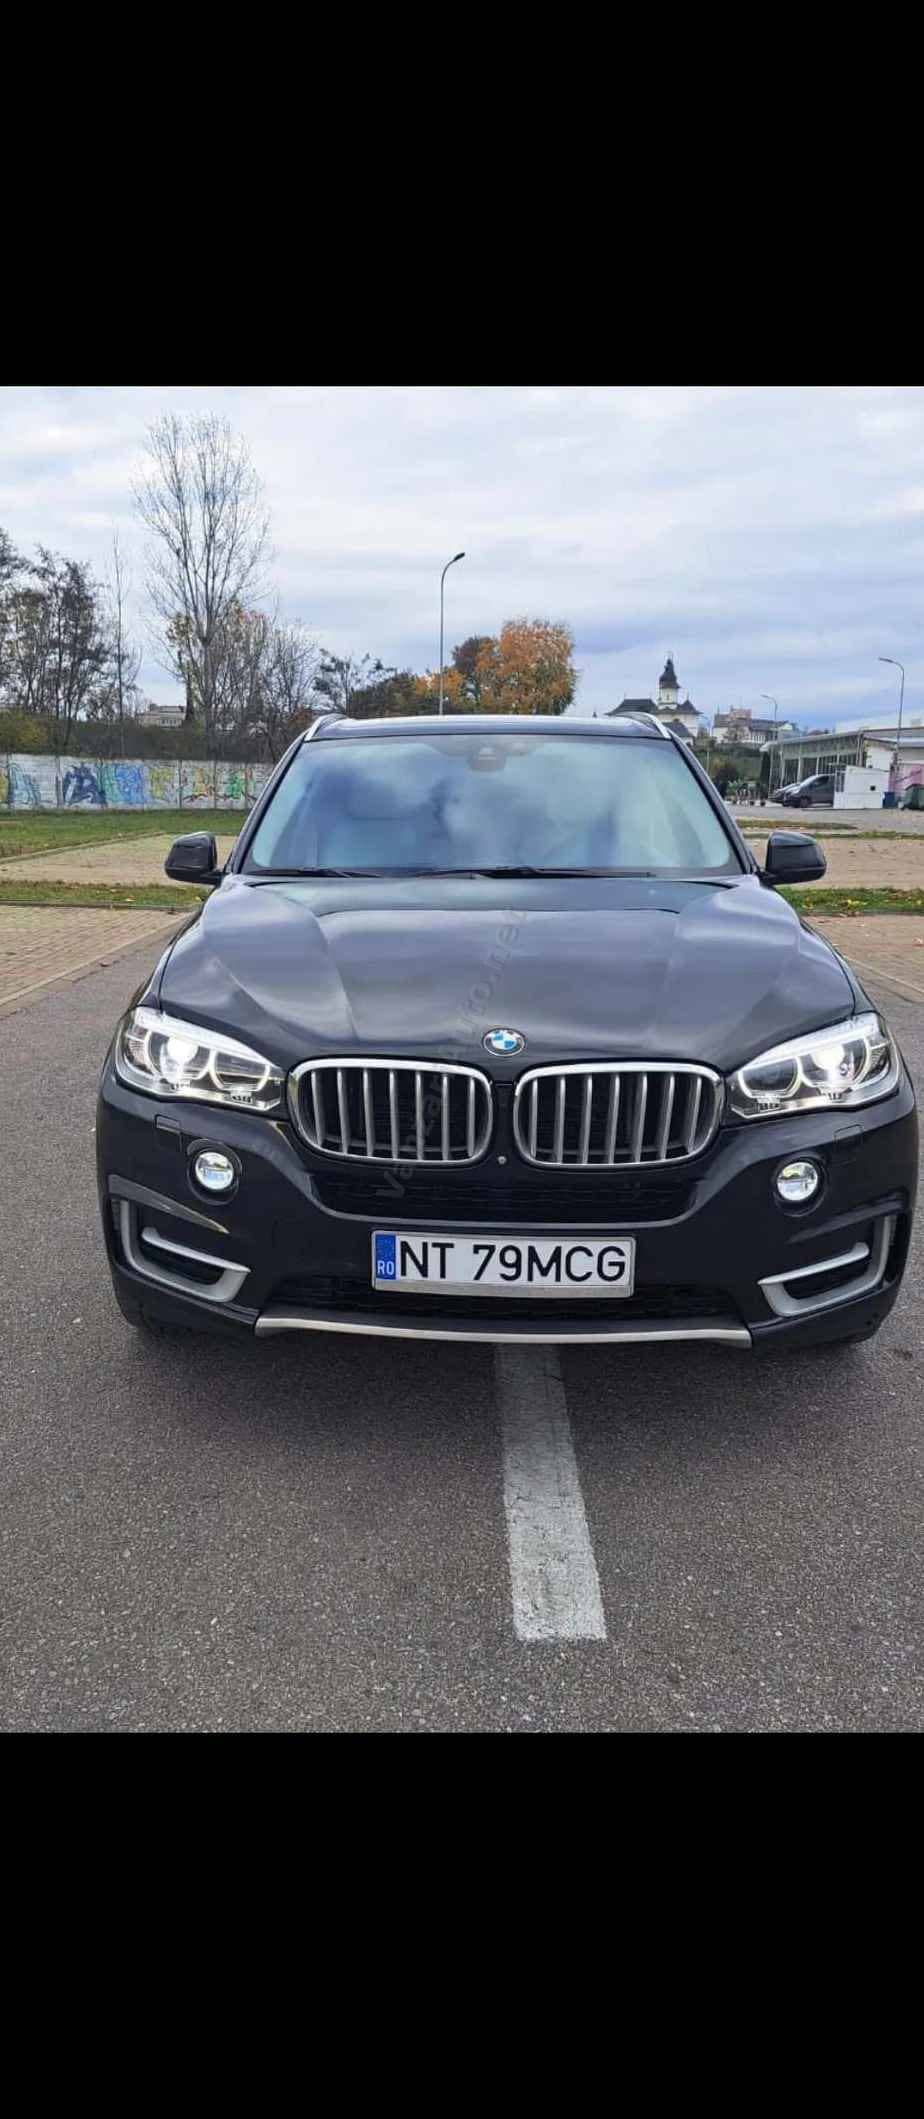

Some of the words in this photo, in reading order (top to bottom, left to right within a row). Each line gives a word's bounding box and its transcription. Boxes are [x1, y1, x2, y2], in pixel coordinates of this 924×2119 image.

[376, 1259, 395, 1276] RO
[400, 1240, 454, 1280] NT
[472, 1243, 626, 1283] 79MCG
